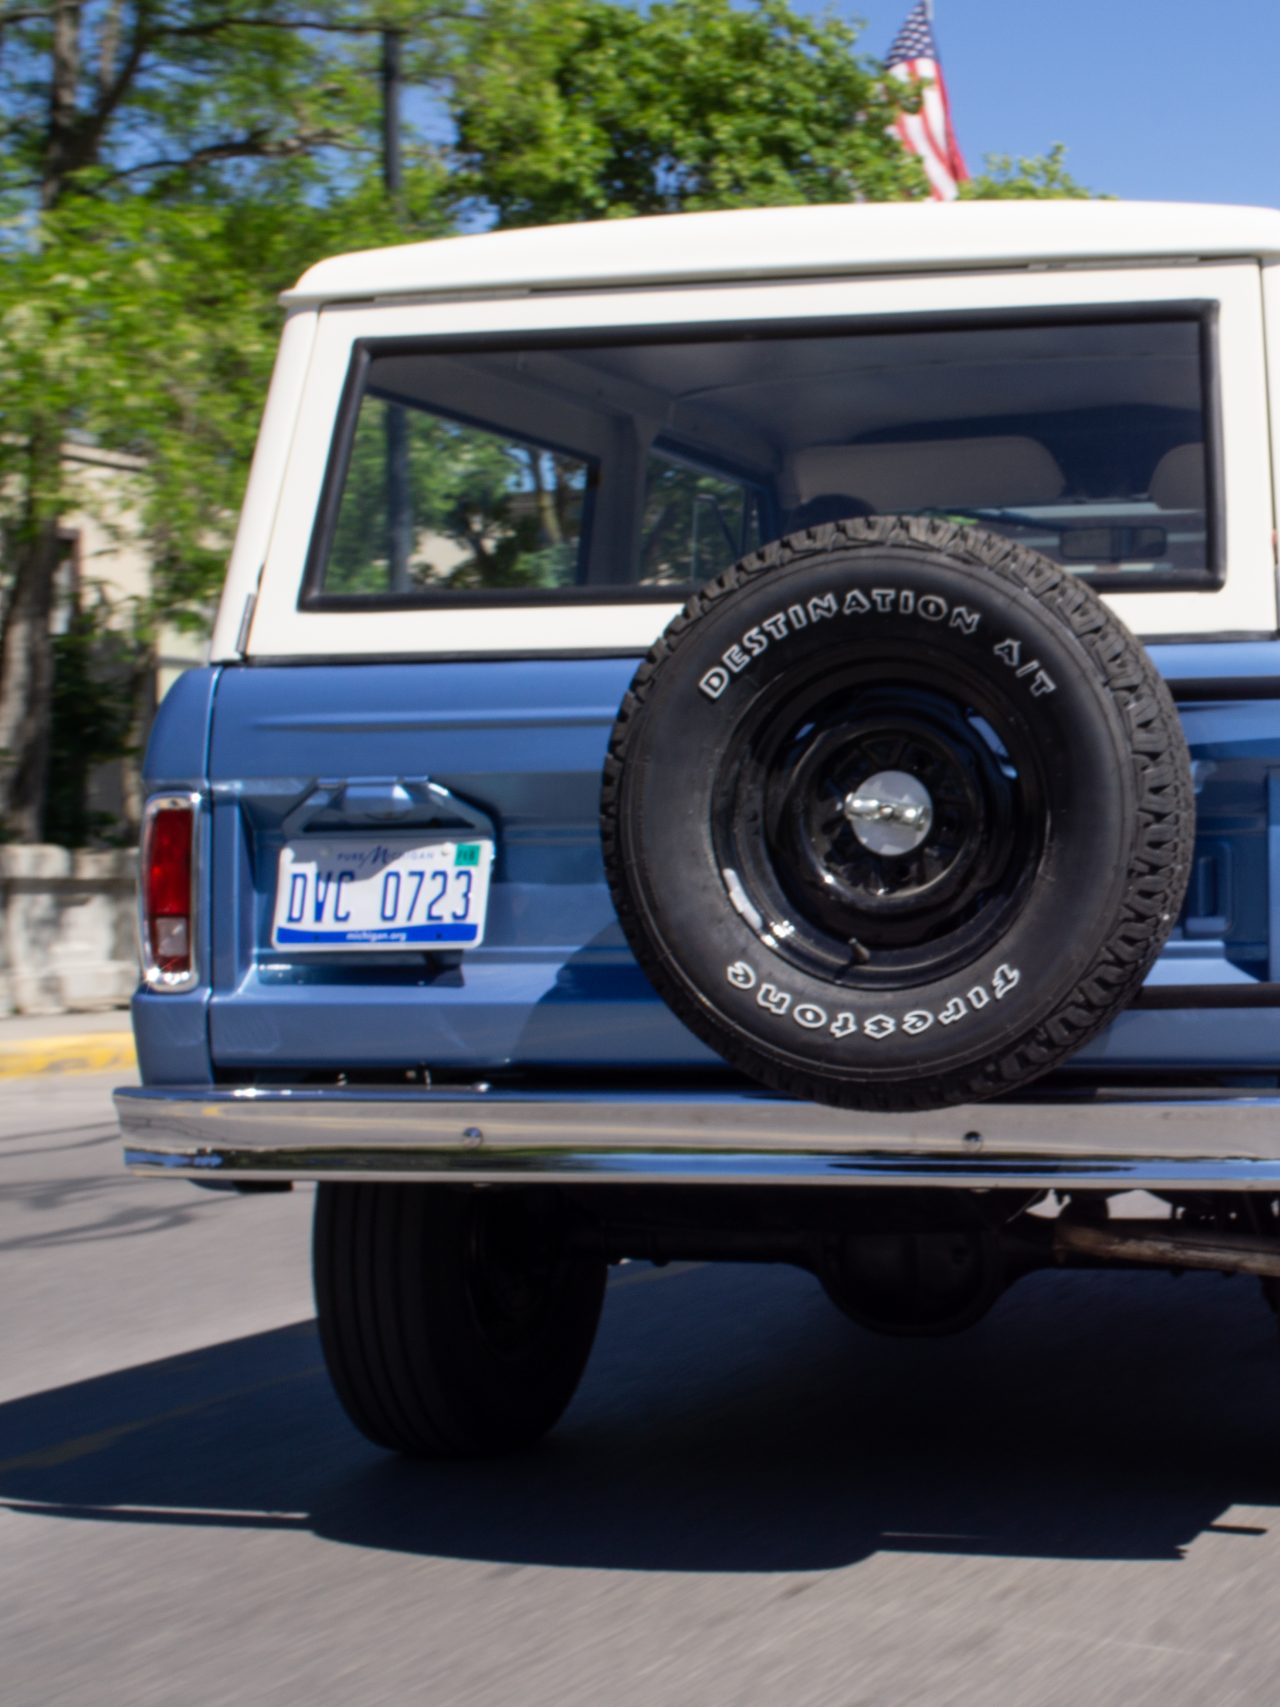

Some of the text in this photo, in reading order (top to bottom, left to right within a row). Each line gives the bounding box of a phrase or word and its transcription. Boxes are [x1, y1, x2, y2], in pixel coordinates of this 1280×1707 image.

[699, 589, 1058, 701] DESTINATION A/T
[287, 870, 473, 923] DVC 0723
[345, 931, 408, 943] michigan.org
[726, 960, 1021, 1040] Firestone
